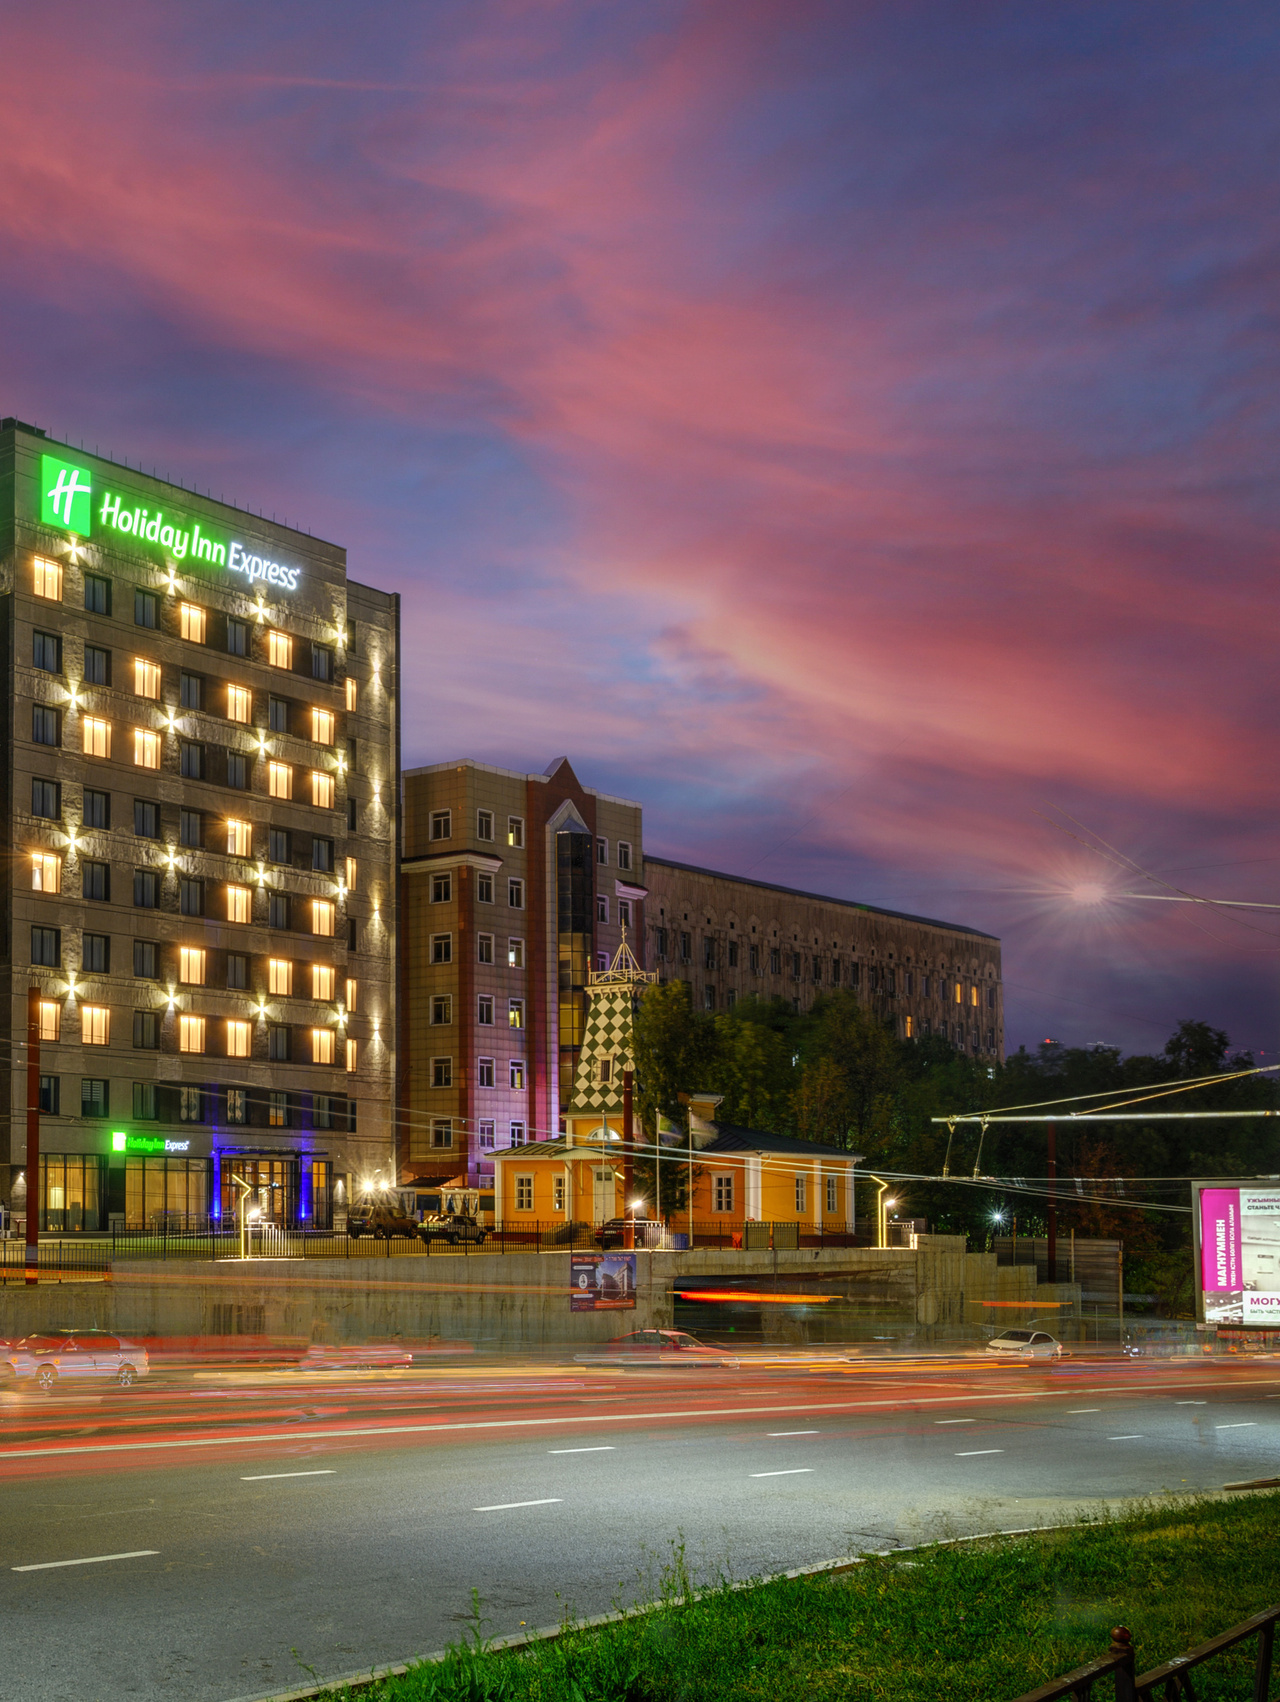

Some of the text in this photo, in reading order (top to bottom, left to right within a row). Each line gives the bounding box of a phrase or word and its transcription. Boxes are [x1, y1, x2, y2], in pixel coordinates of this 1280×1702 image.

[99, 492, 299, 590] Holiday Inn Express
[127, 1137, 188, 1152] Holiday Inn Express
[1216, 1219, 1227, 1287] МАГНУММЕН
